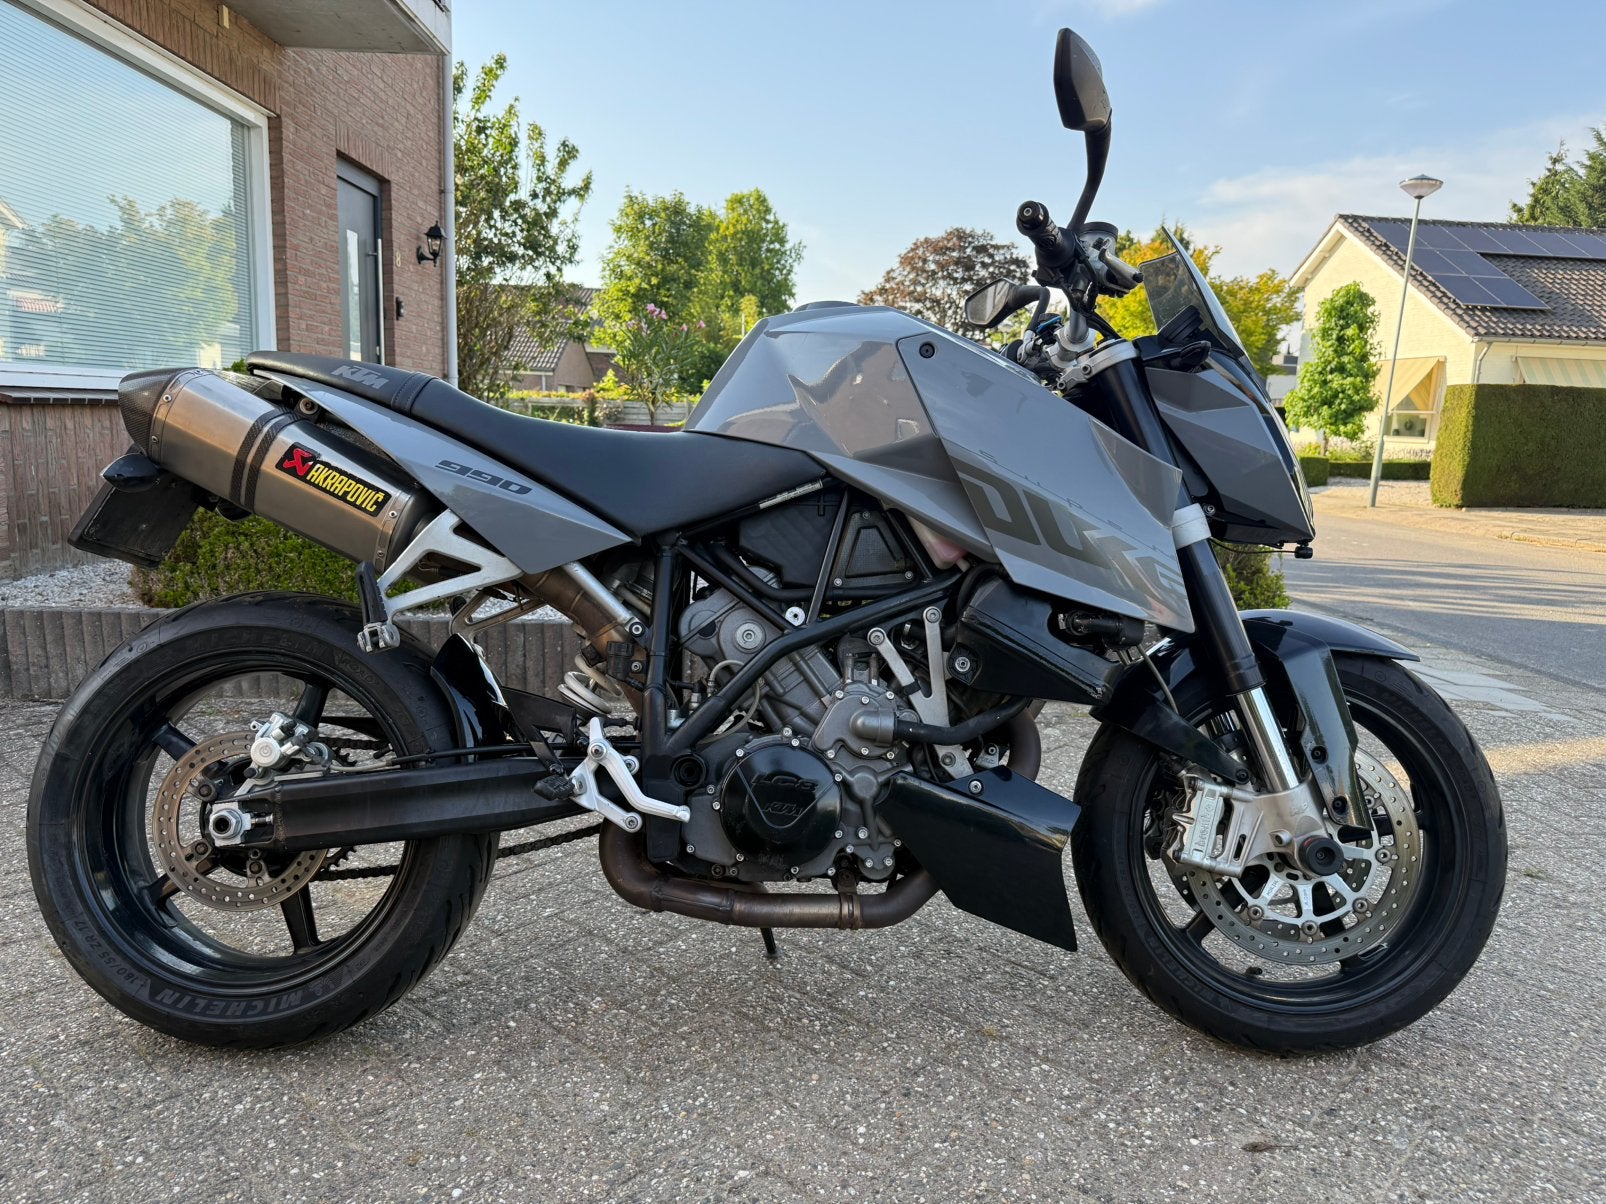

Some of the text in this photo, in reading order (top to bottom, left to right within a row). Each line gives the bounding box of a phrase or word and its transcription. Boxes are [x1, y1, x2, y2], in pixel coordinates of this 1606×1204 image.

[331, 365, 389, 390] KTM
[434, 459, 533, 495] 990
[950, 454, 1189, 612] DUKE
[74, 920, 303, 1017] MICHELIN 180/55 ZR 17
